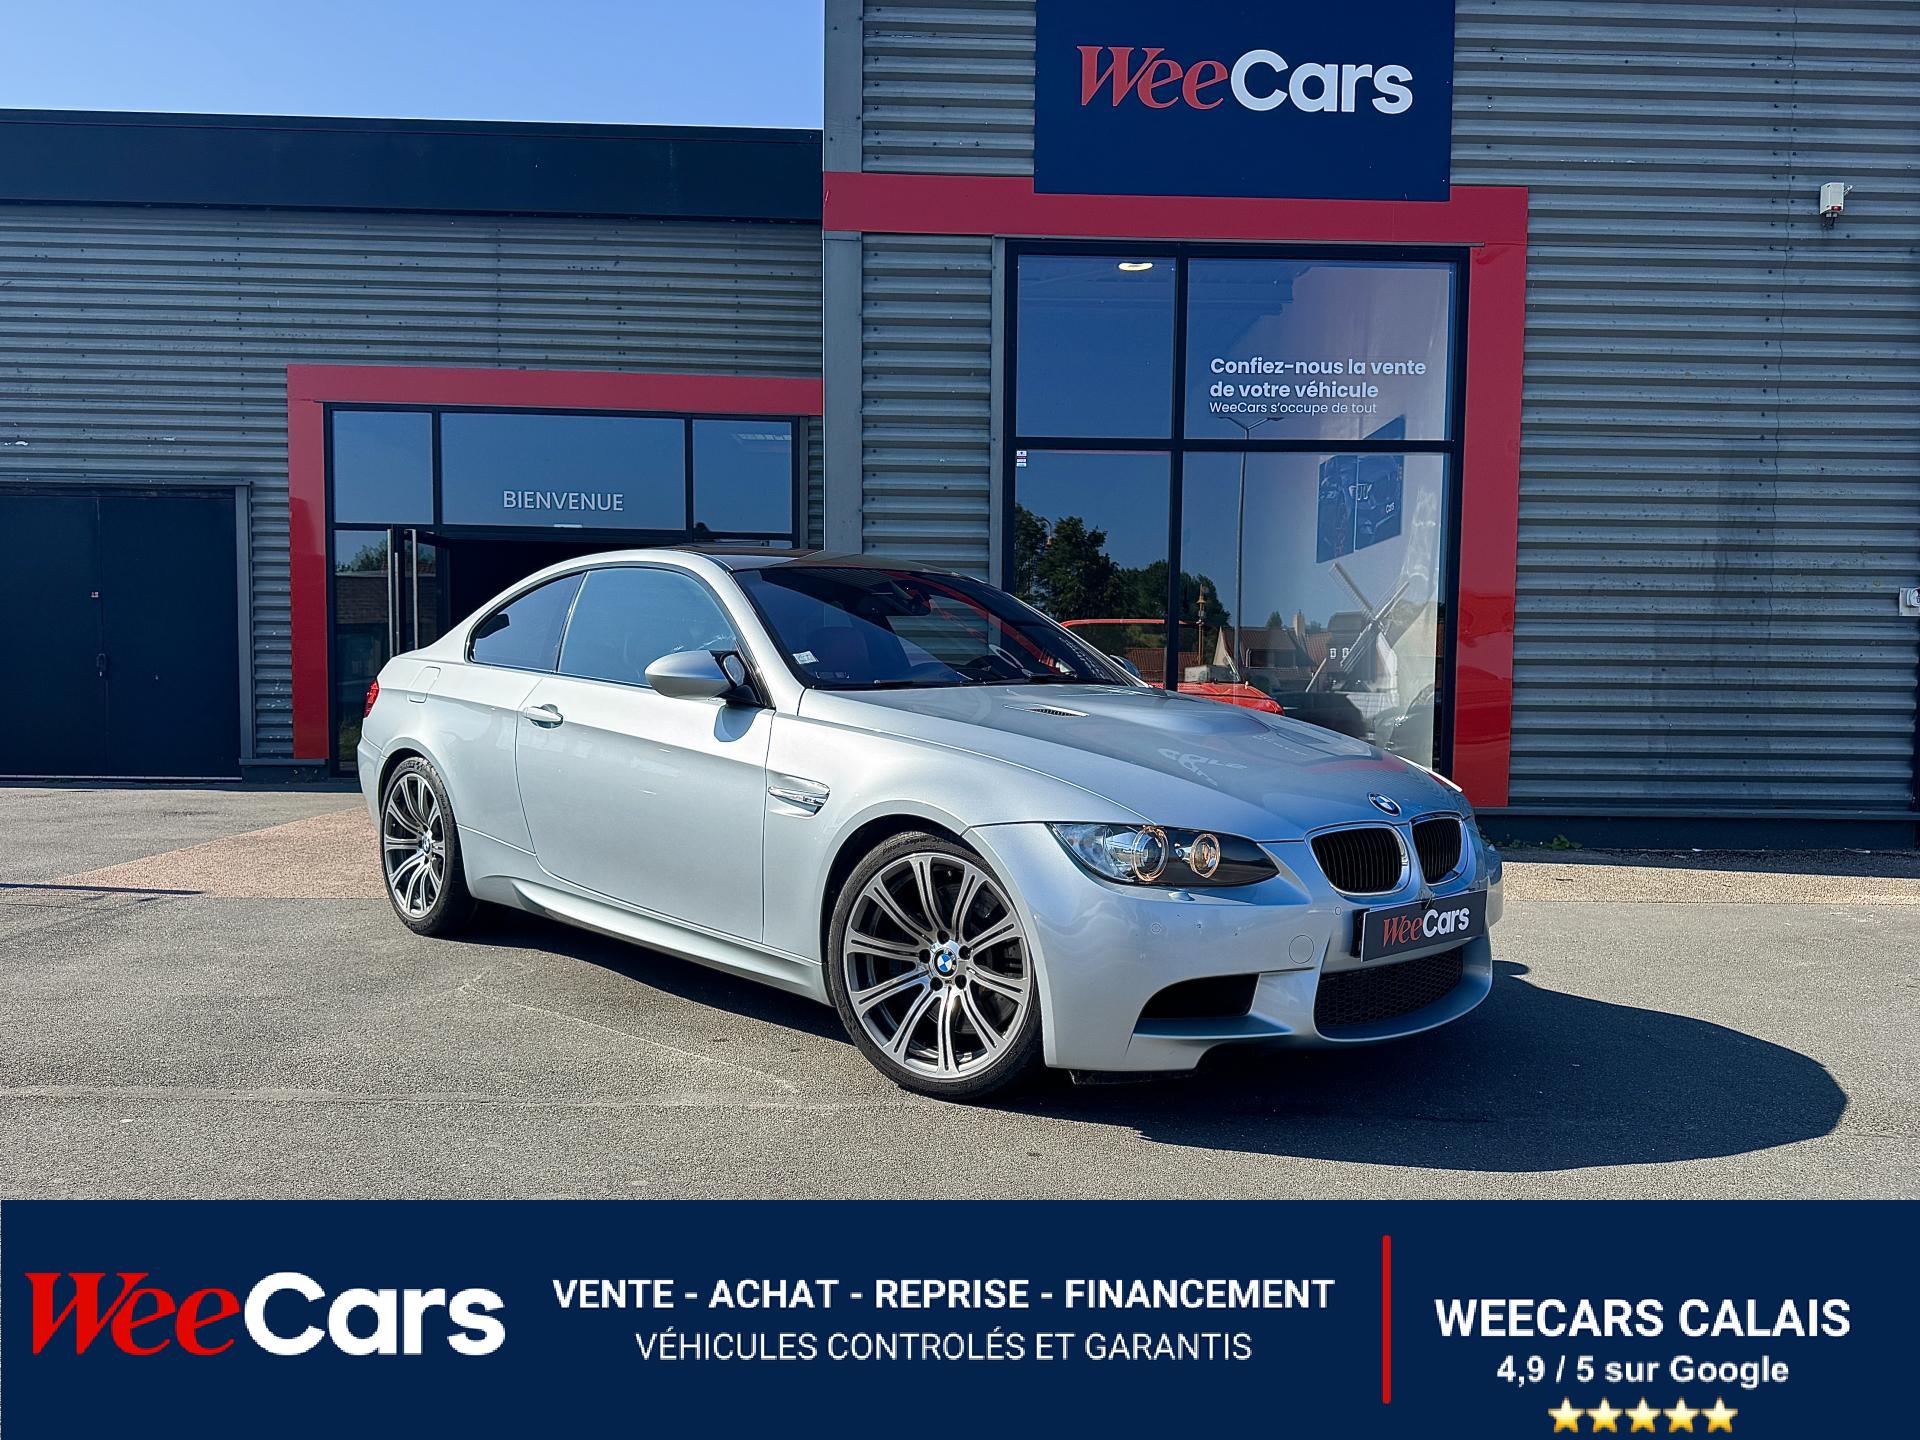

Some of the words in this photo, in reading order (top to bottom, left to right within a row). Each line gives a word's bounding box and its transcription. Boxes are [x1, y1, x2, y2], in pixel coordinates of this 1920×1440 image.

[1076, 45, 1414, 115] WeeCars
[1210, 357, 1343, 374] Confiez-nous
[1348, 358, 1366, 375] la
[1370, 360, 1426, 375] vente
[1209, 380, 1235, 397] de
[1238, 382, 1291, 398] votre
[1294, 380, 1379, 398] véhicule
[1209, 402, 1267, 413] WeeCars
[1331, 402, 1348, 413] de
[1351, 403, 1377, 414] tout
[502, 490, 624, 511] BIENVENUE
[1383, 907, 1470, 947] WeeCars
